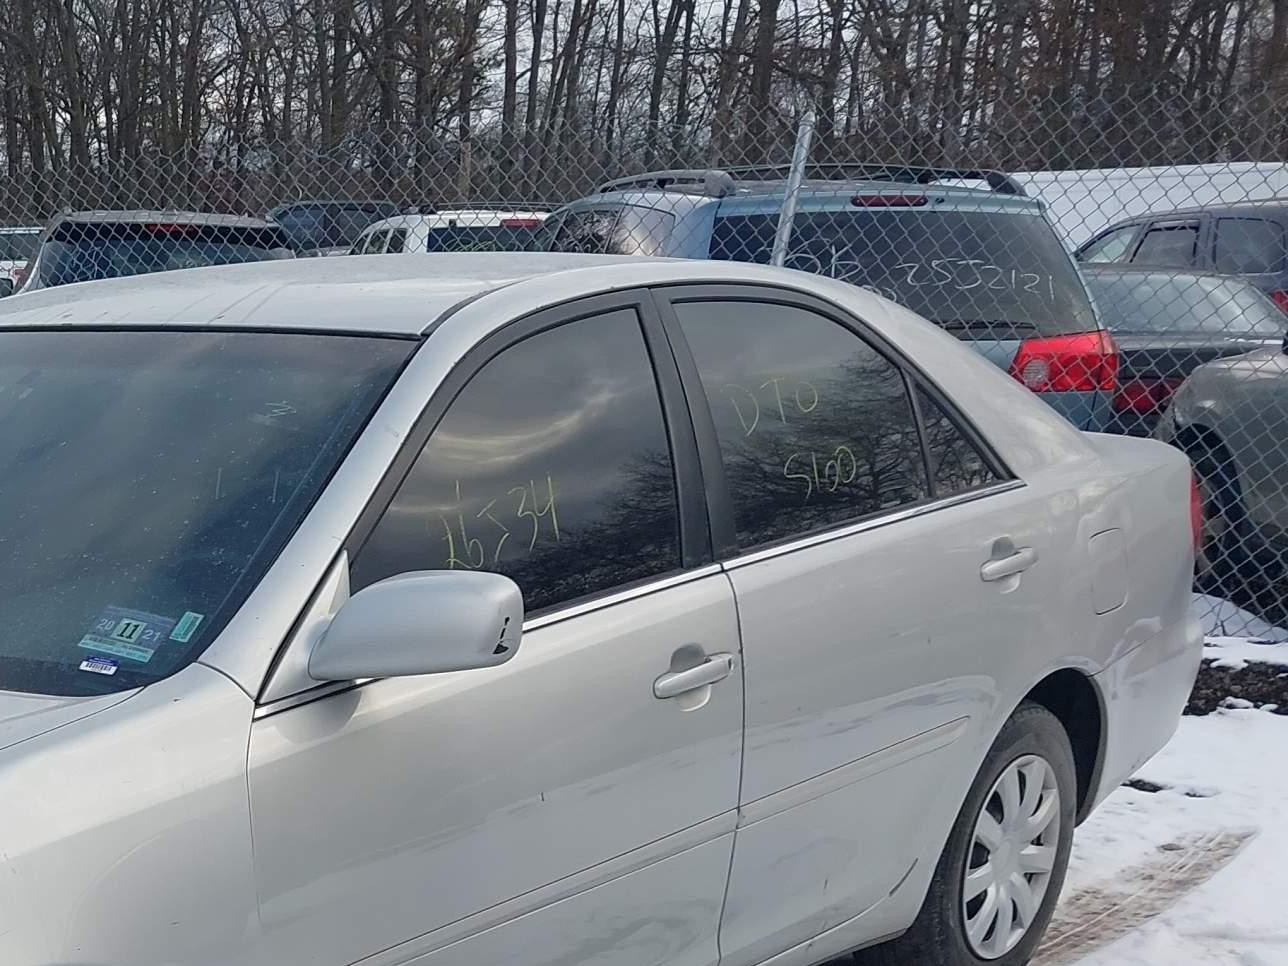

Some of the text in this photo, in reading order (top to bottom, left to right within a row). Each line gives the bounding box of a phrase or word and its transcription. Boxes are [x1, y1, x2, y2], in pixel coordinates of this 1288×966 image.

[97, 618, 161, 641] 20 11 21
